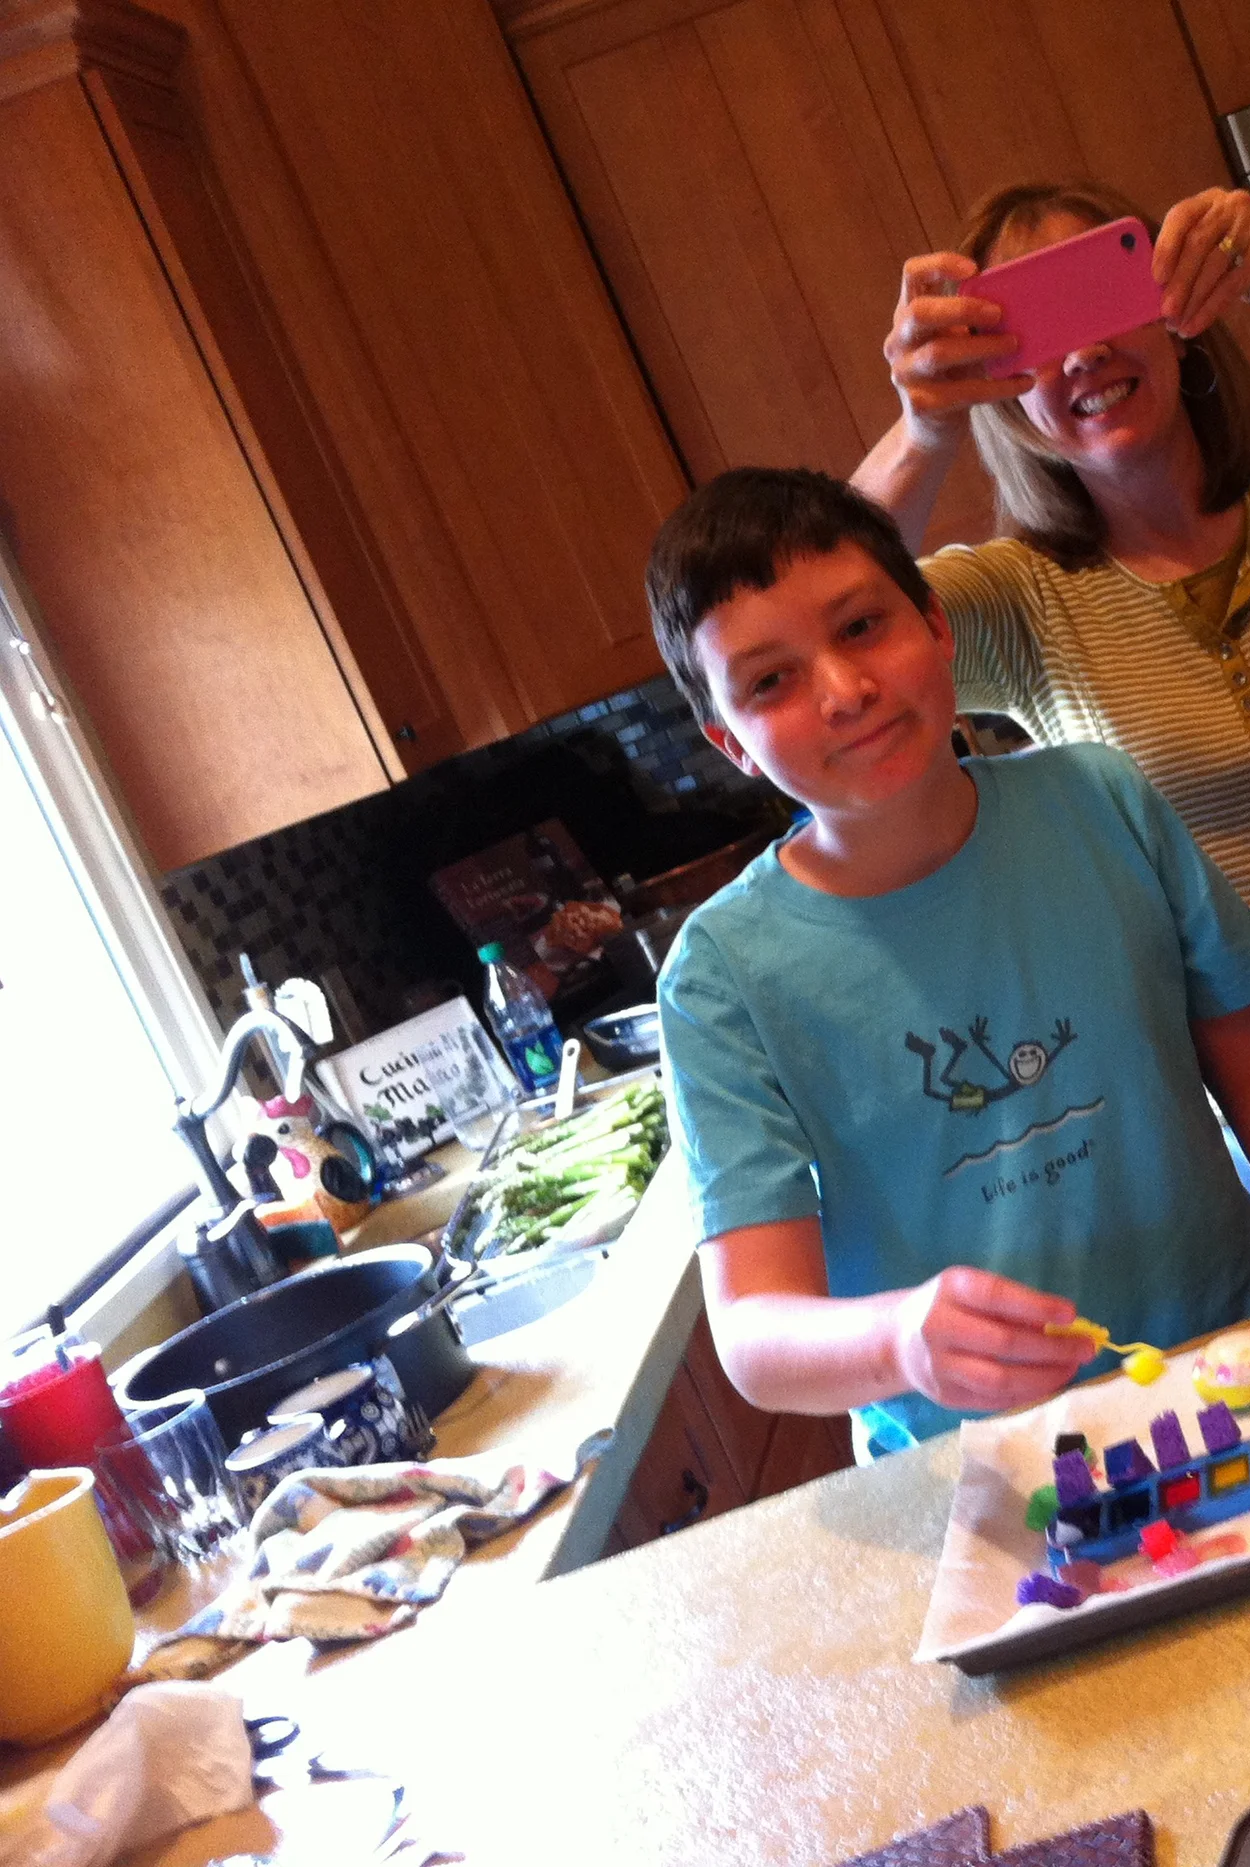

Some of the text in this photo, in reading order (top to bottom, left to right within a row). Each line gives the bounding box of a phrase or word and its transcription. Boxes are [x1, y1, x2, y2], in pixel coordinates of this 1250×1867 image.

[981, 1139, 1090, 1204] Life is good
